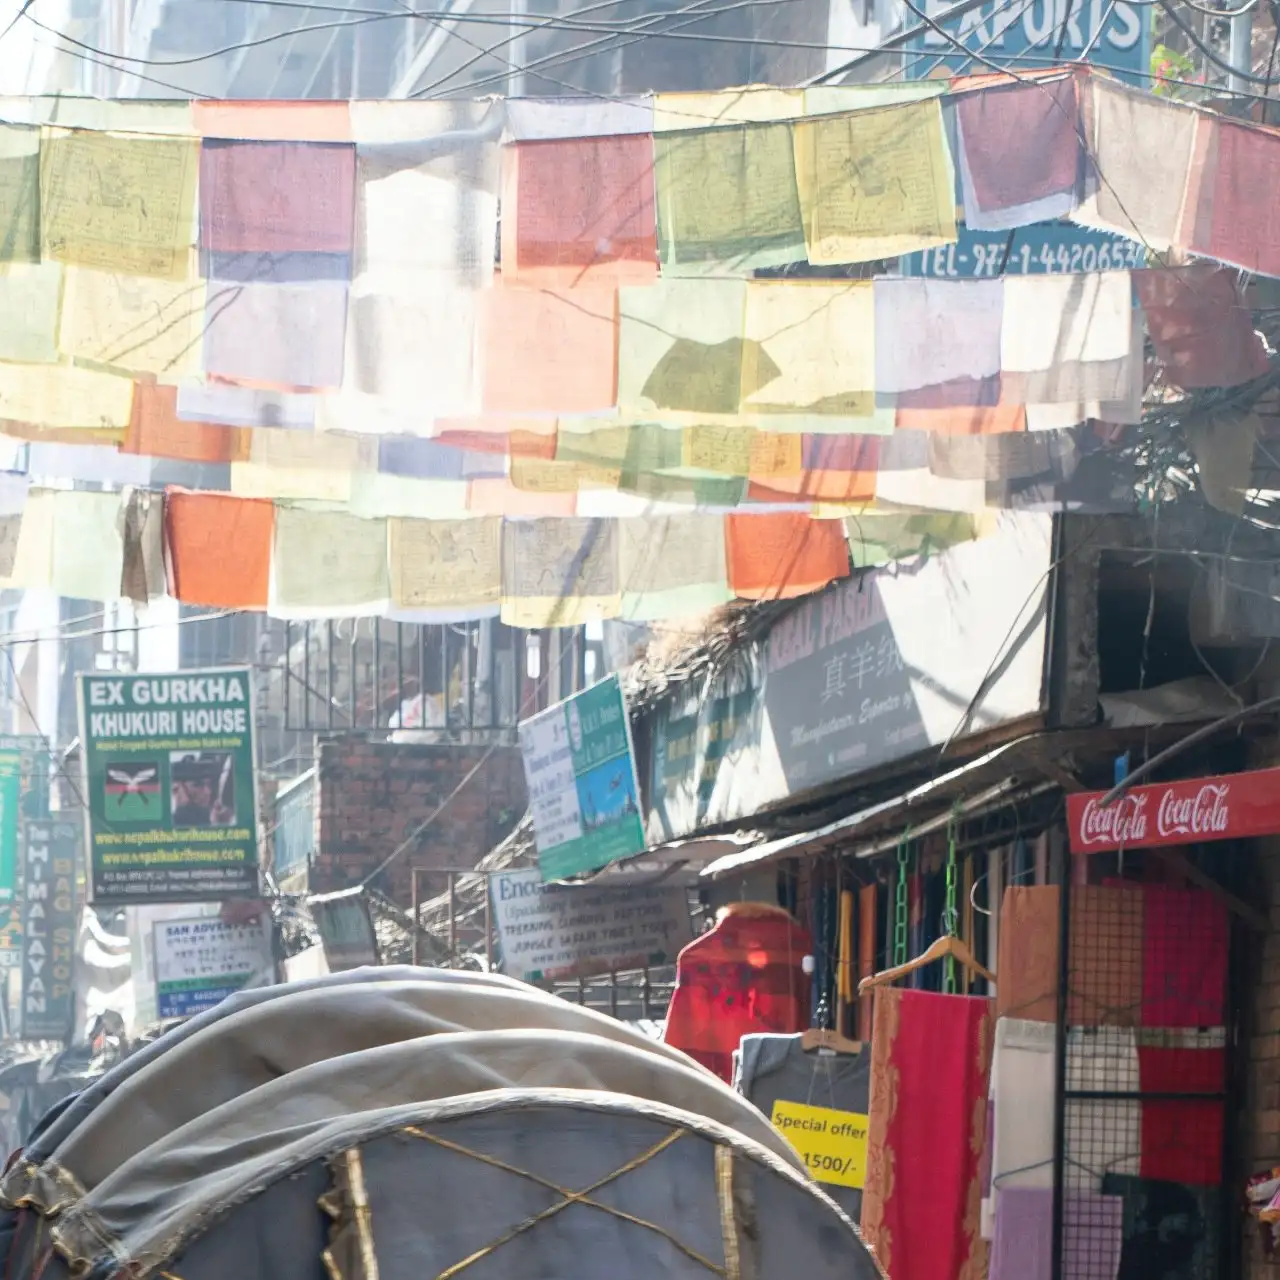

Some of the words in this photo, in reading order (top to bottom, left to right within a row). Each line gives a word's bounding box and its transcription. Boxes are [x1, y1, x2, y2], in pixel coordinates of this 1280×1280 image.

[90, 681, 125, 706] EX
[132, 677, 245, 705] GURKHA
[91, 709, 177, 738] KHUKURI
[182, 707, 247, 735] HOUSE
[52, 857, 71, 912] BAG
[26, 846, 48, 1013] HIMALAYAN
[52, 928, 71, 999] SHOP
[775, 1112, 827, 1133] Special
[830, 1122, 867, 1140] offer
[803, 1152, 857, 1176] 1500/-
